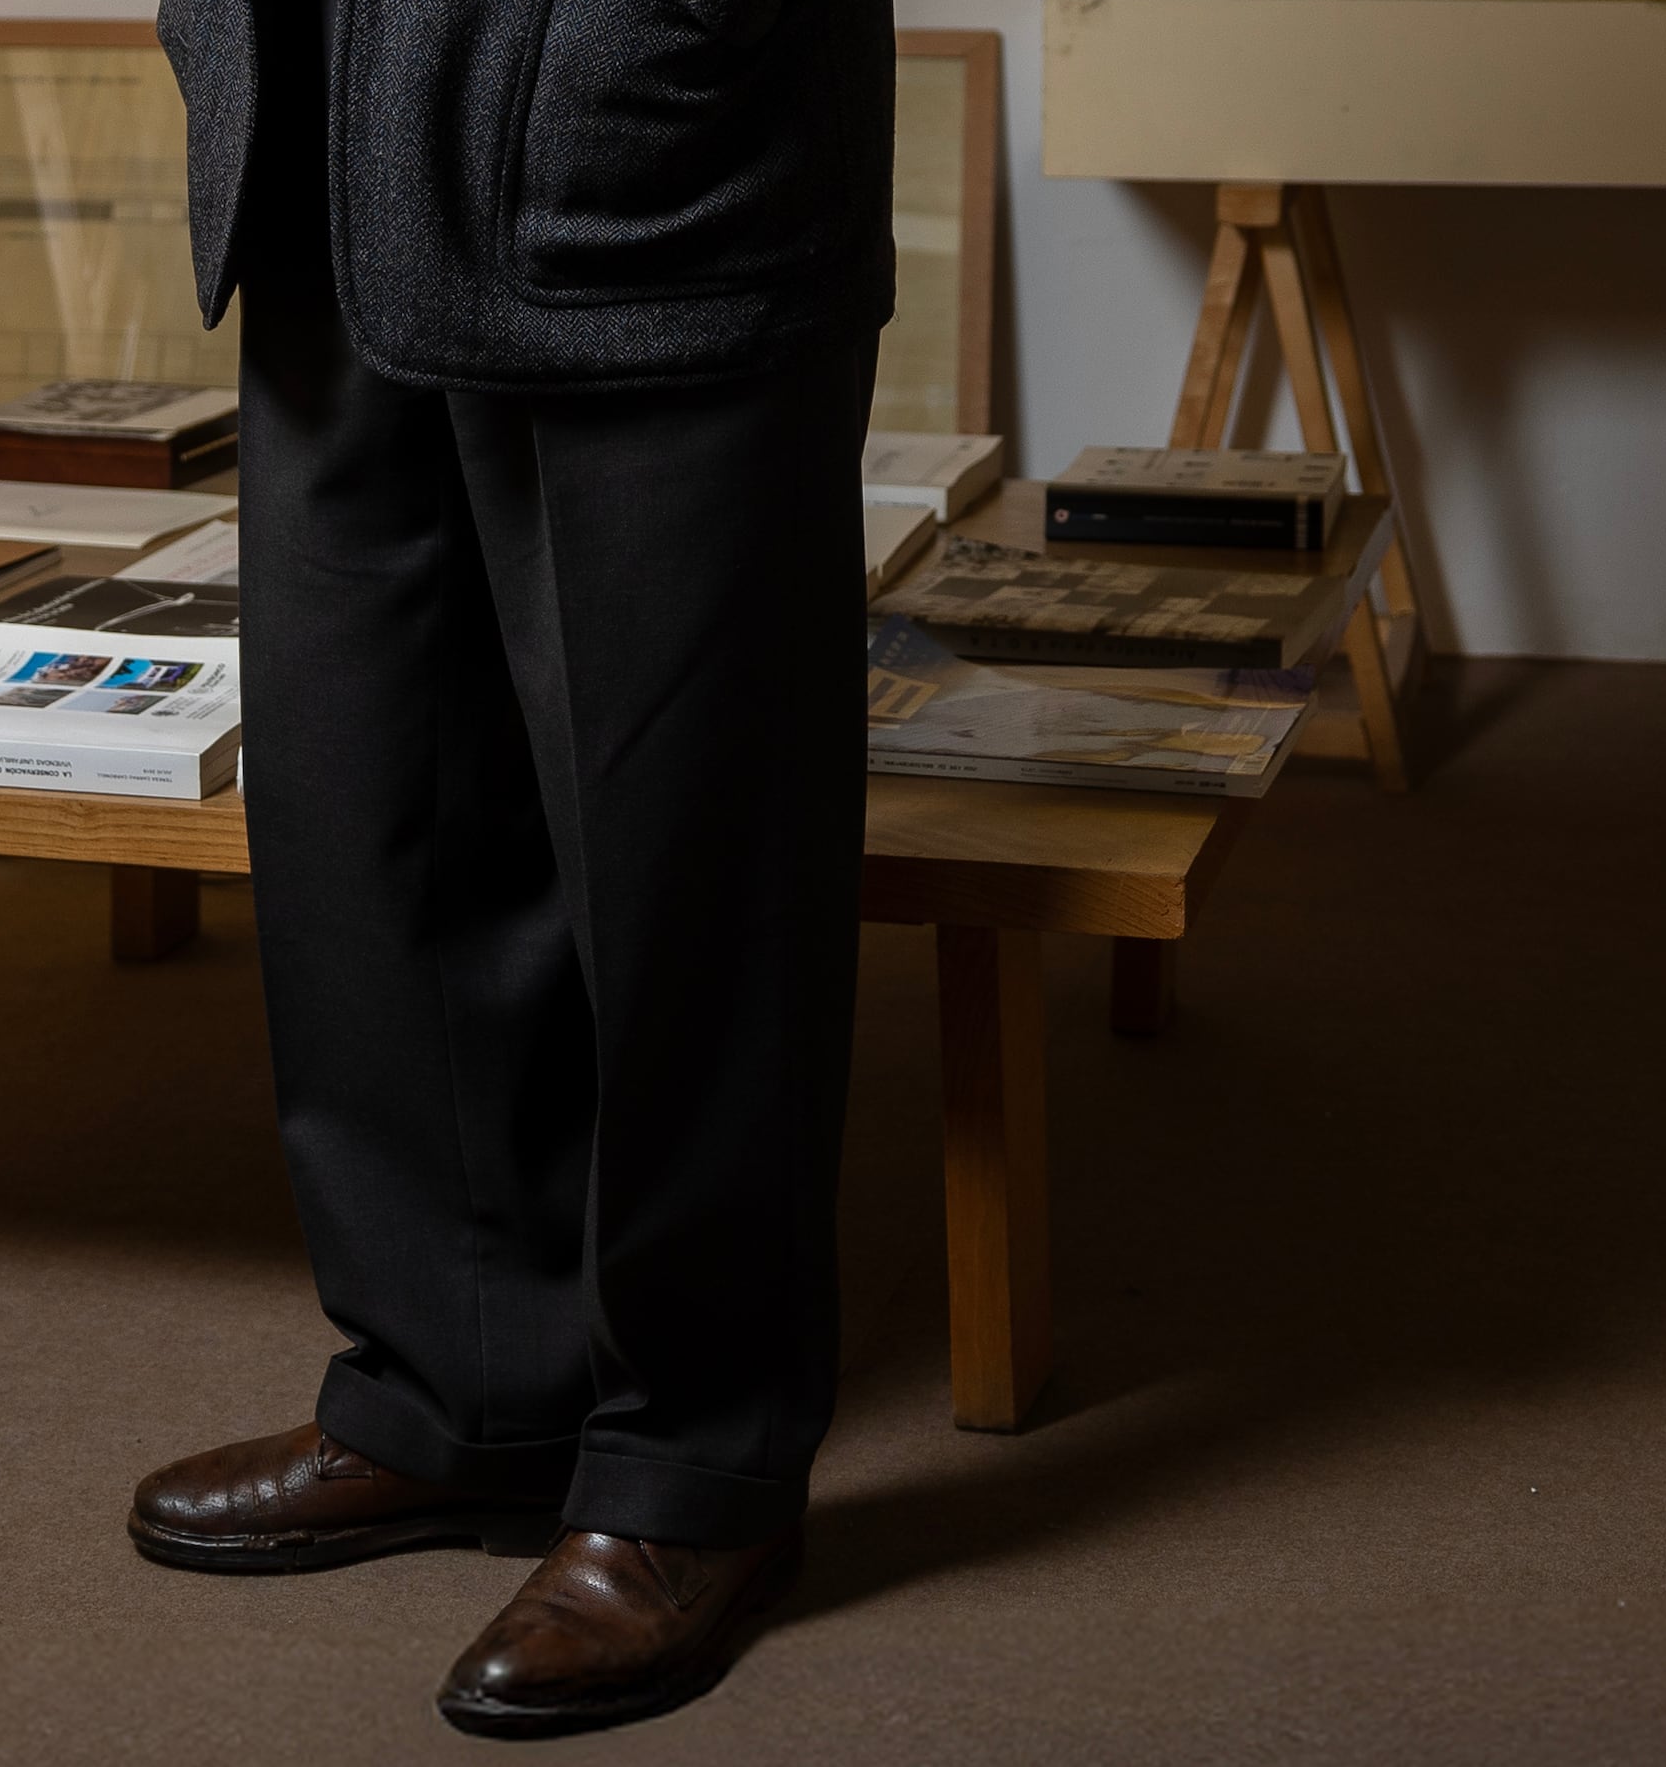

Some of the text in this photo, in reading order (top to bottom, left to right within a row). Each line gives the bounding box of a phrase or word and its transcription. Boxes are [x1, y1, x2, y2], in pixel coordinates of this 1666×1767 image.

[35, 758, 72, 768] VIVIENDAS
[4, 767, 60, 777] CONSERVACIÓN
[62, 770, 72, 778] LA
